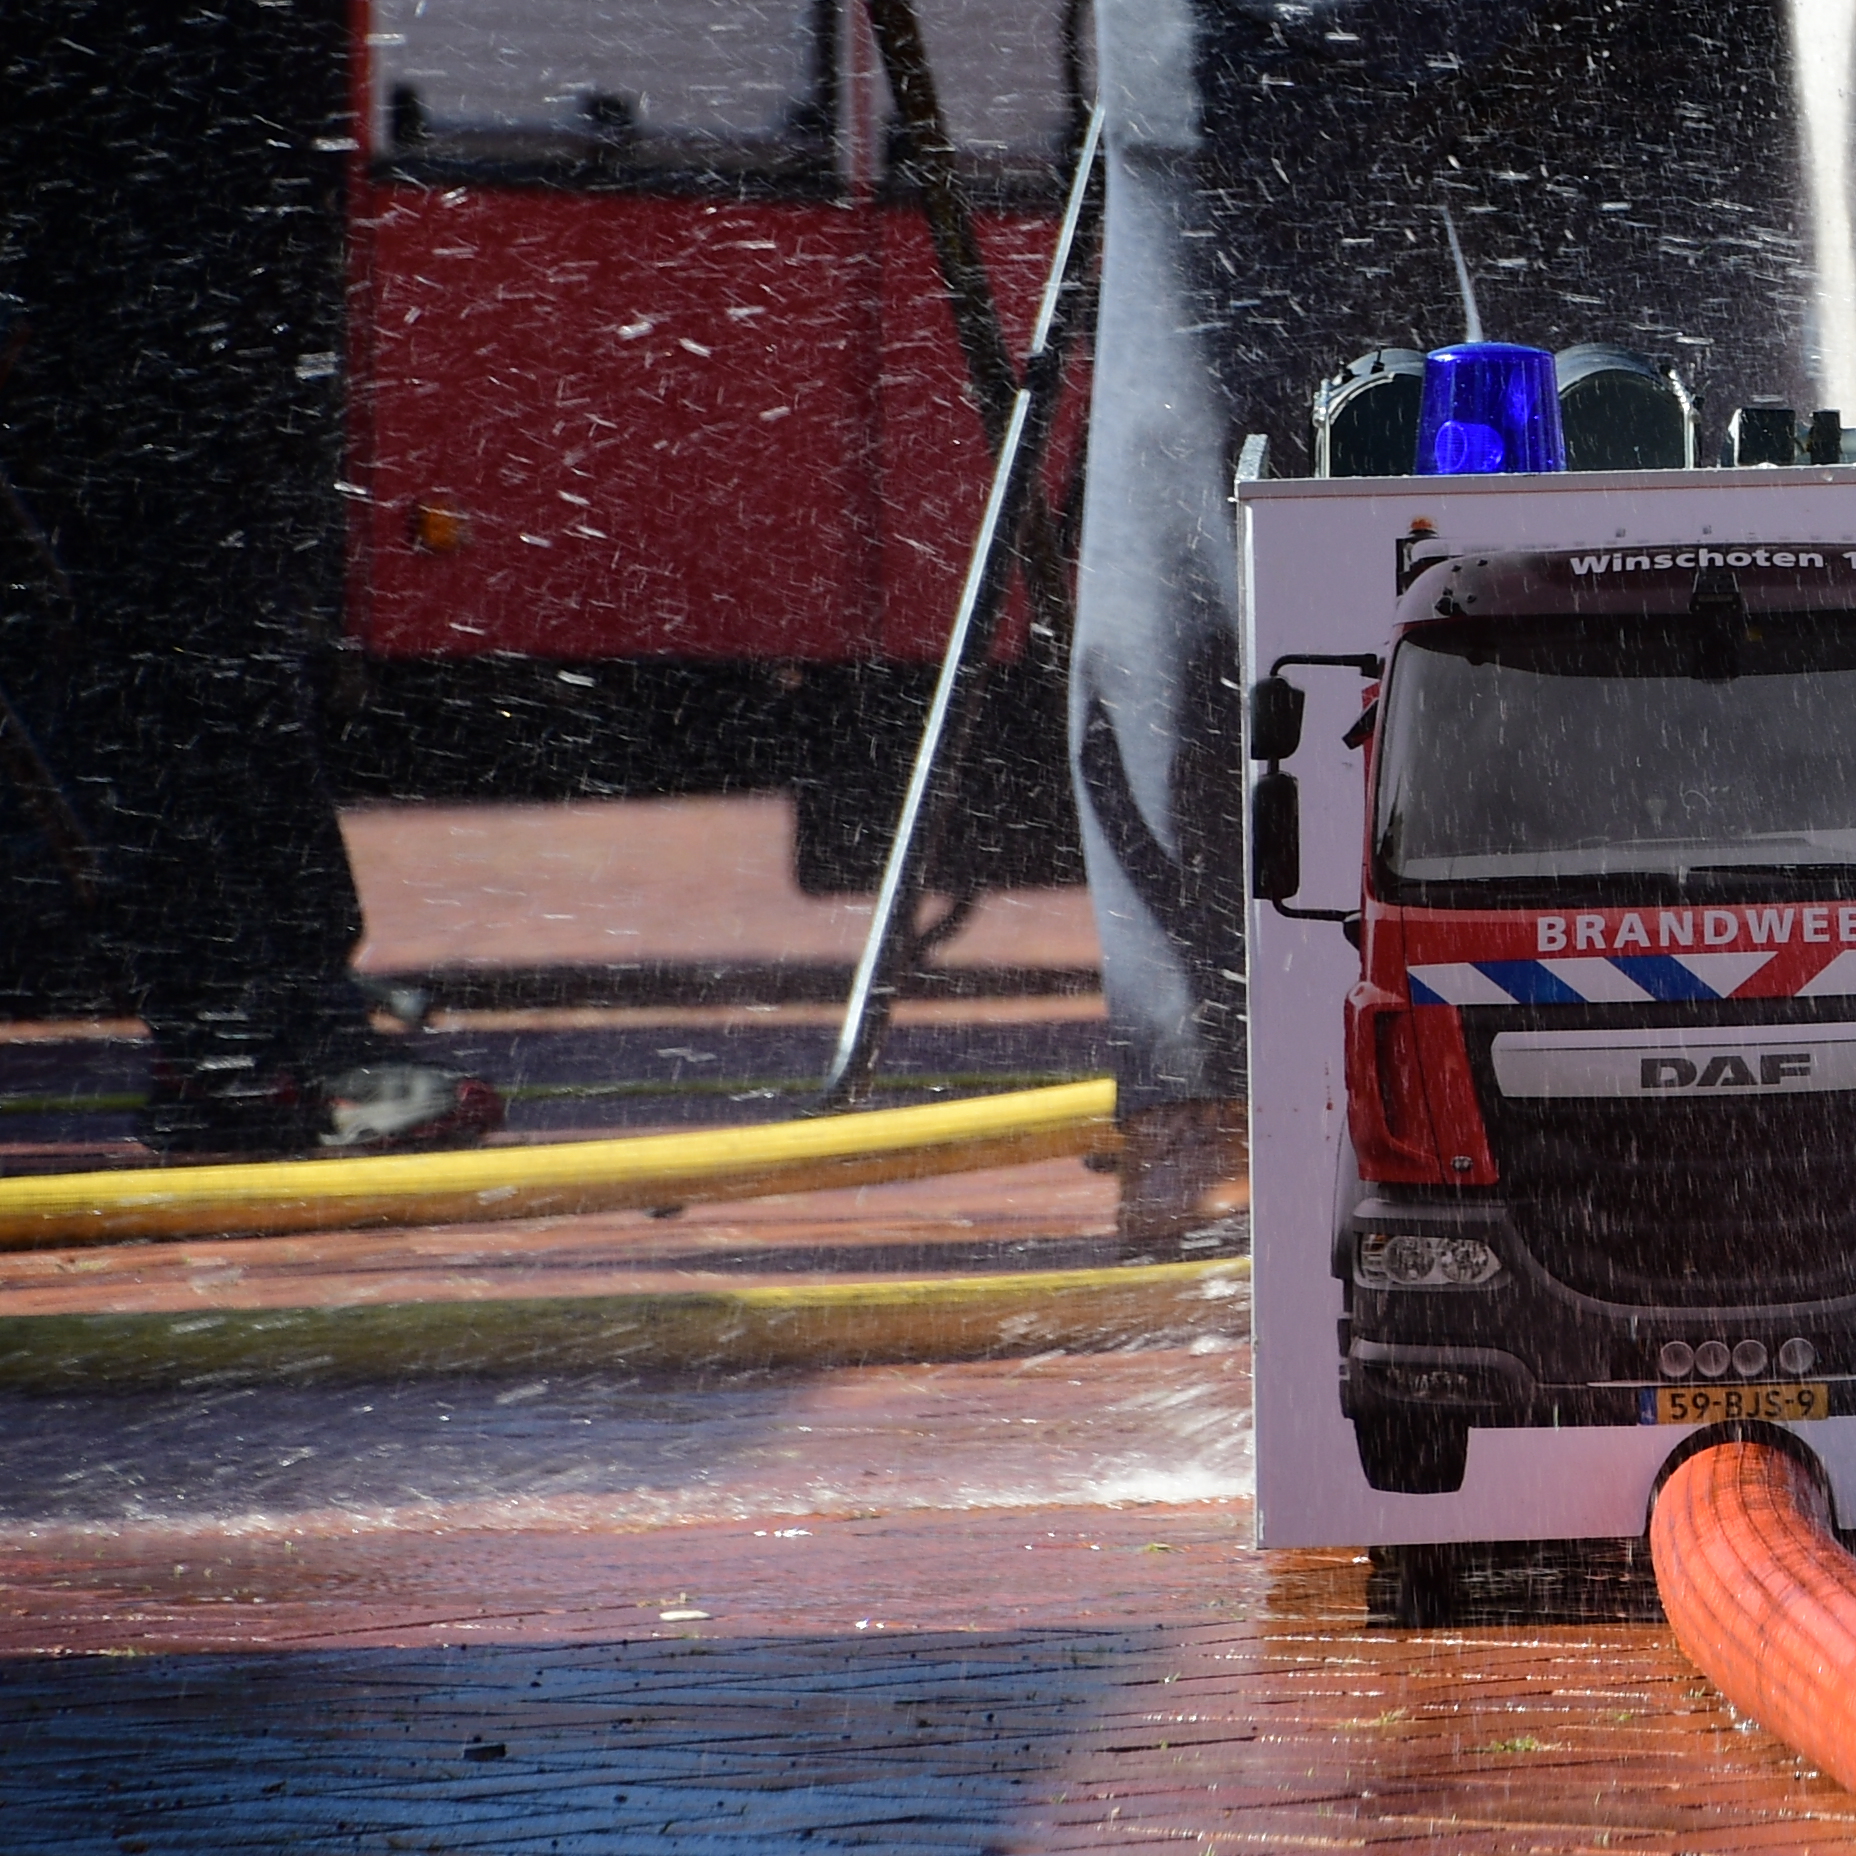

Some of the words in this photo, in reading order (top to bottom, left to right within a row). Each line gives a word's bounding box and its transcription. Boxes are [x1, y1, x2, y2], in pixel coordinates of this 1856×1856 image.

[1569, 547, 1824, 576] Winschoten
[1641, 1053, 1811, 1089] DAF
[1670, 1389, 1815, 1421] 59-BJS-9
